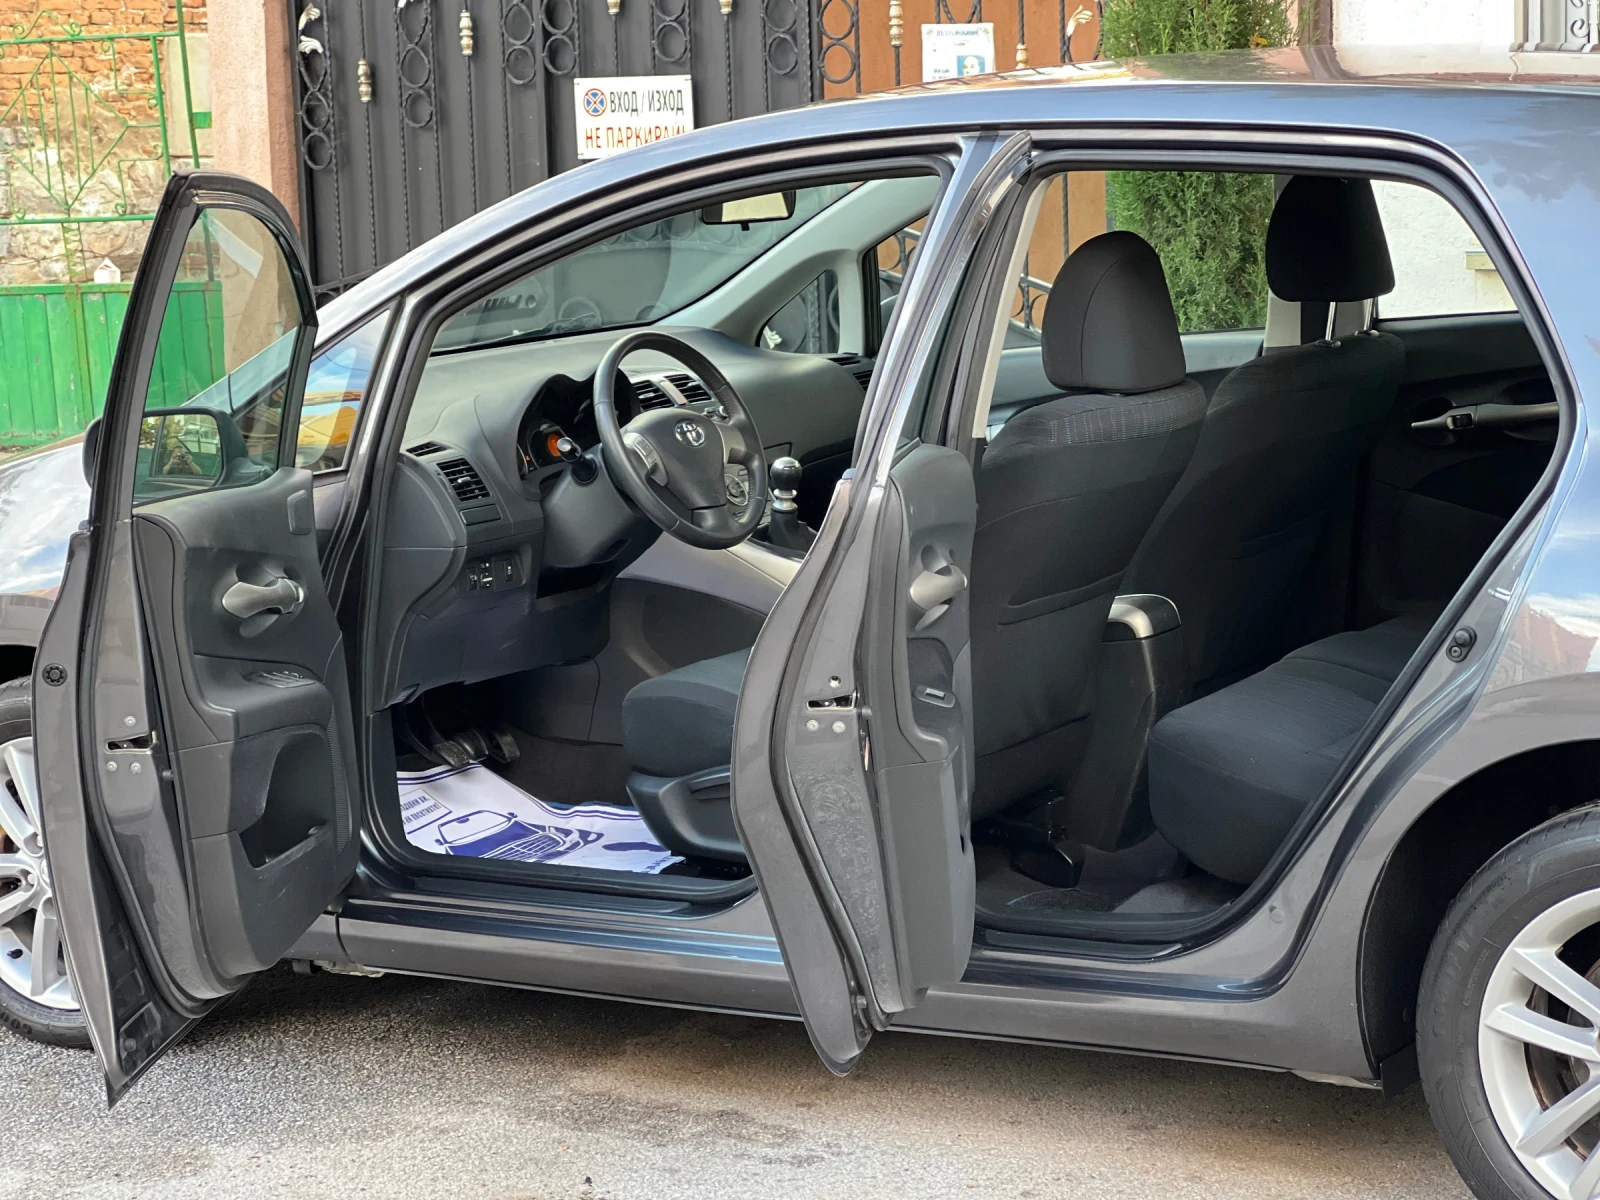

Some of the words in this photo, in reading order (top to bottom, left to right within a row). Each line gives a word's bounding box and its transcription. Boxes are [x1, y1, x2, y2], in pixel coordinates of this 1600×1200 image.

[609, 91, 639, 117] ВХОД
[647, 89, 685, 116] ИЗХОД
[585, 127, 602, 149] НЕ
